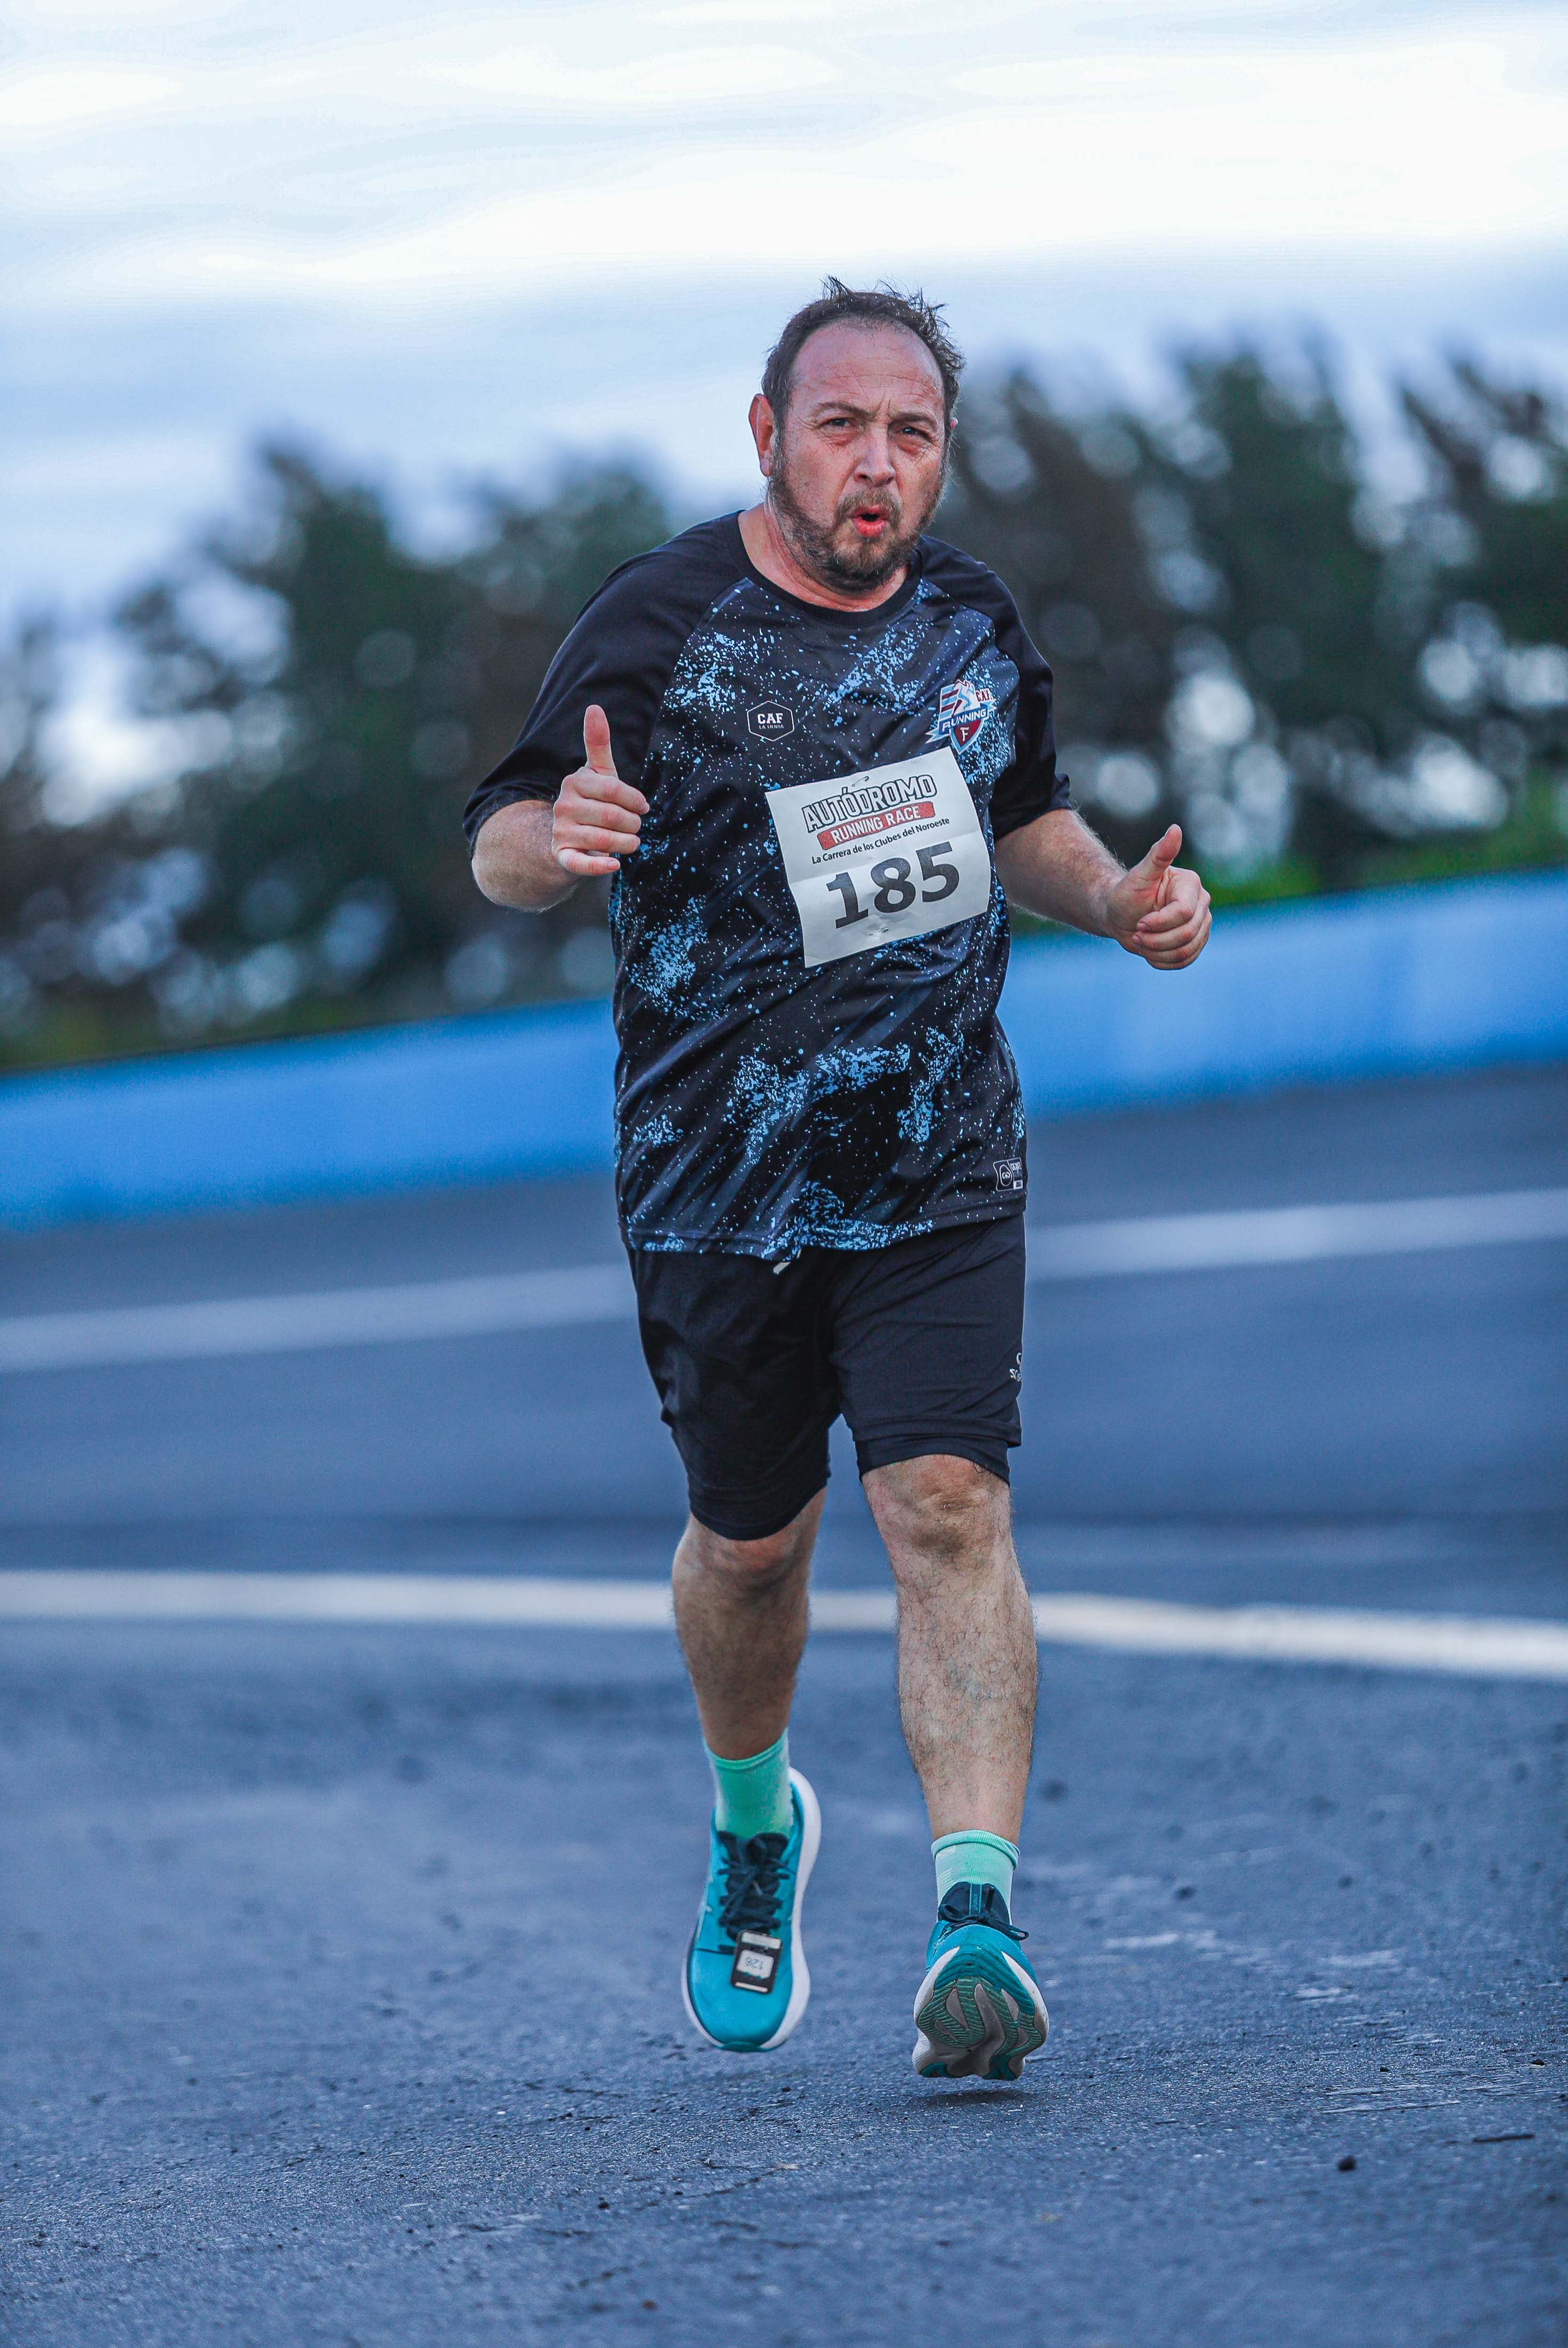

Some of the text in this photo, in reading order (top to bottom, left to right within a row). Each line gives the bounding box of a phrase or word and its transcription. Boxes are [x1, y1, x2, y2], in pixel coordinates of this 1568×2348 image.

[757, 713, 783, 724] CAF
[942, 709, 986, 732] RUNNING
[960, 727, 969, 742] F
[801, 774, 937, 833] AUTÓDROMO
[812, 856, 821, 864] La
[823, 849, 851, 861] Carrera
[852, 845, 863, 854] de
[875, 832, 901, 848] Clubes
[903, 826, 915, 837] del
[916, 818, 950, 832] Noroeste
[830, 806, 921, 844] RUNNING RACE
[826, 841, 960, 929] 185
